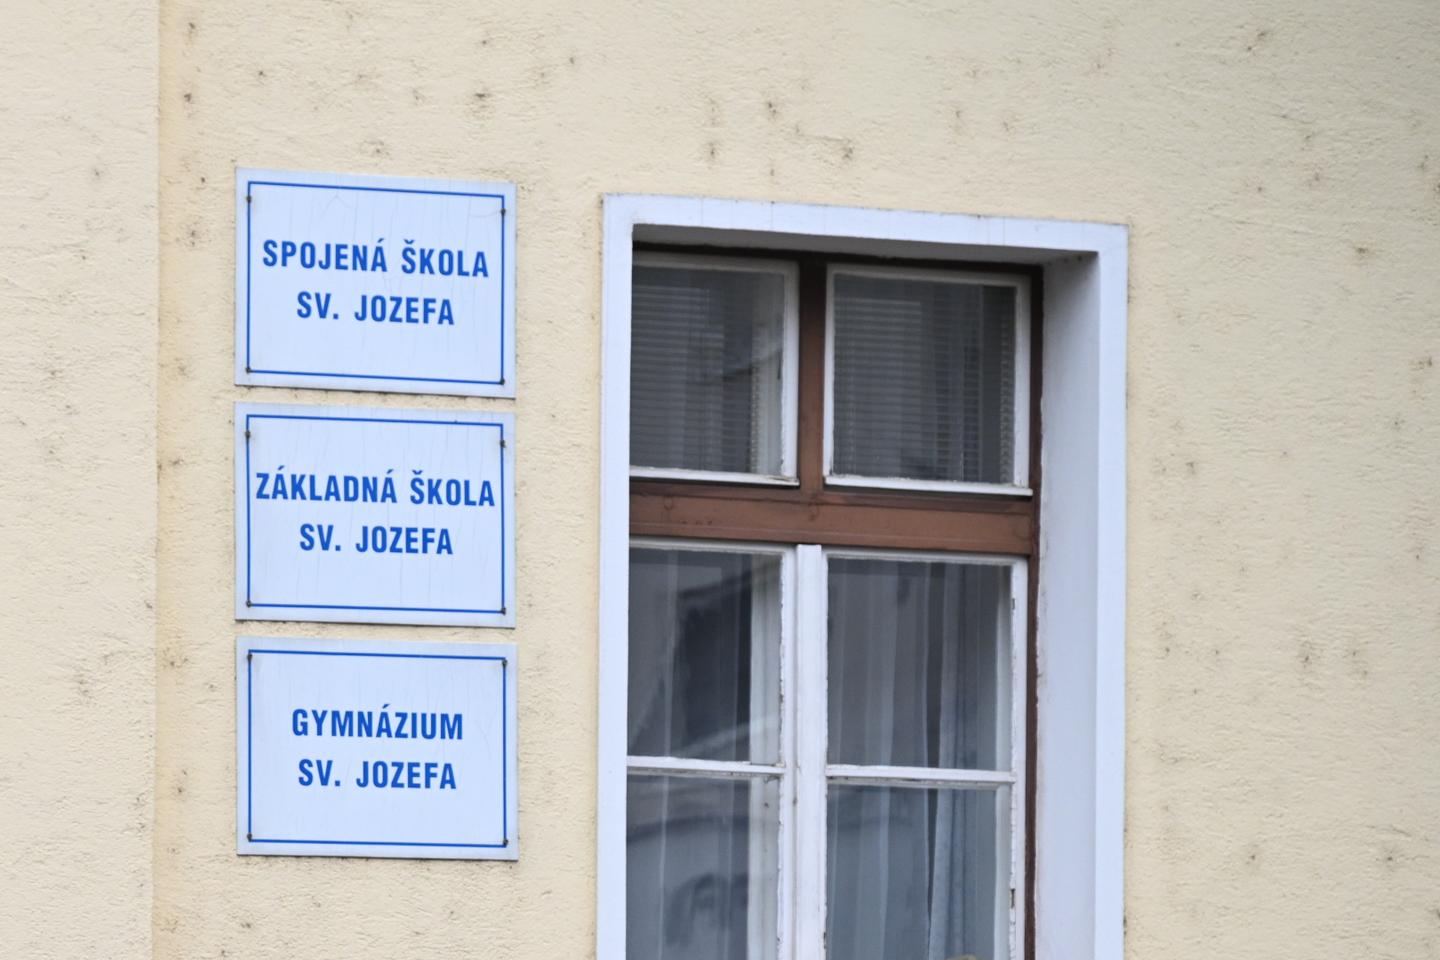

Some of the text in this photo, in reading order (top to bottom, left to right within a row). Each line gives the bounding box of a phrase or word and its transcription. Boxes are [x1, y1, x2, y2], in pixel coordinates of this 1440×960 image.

[263, 238, 488, 277] SPOJENÁ ŠKOLA
[297, 291, 454, 325] SV. JOZEFA
[256, 465, 495, 506] ZÁKLADNÁ ŠKOLA
[300, 523, 453, 554] SV. JOZEFA
[292, 703, 463, 740] GYMNÁZIUM
[298, 759, 456, 789] SV. JOZEFA
